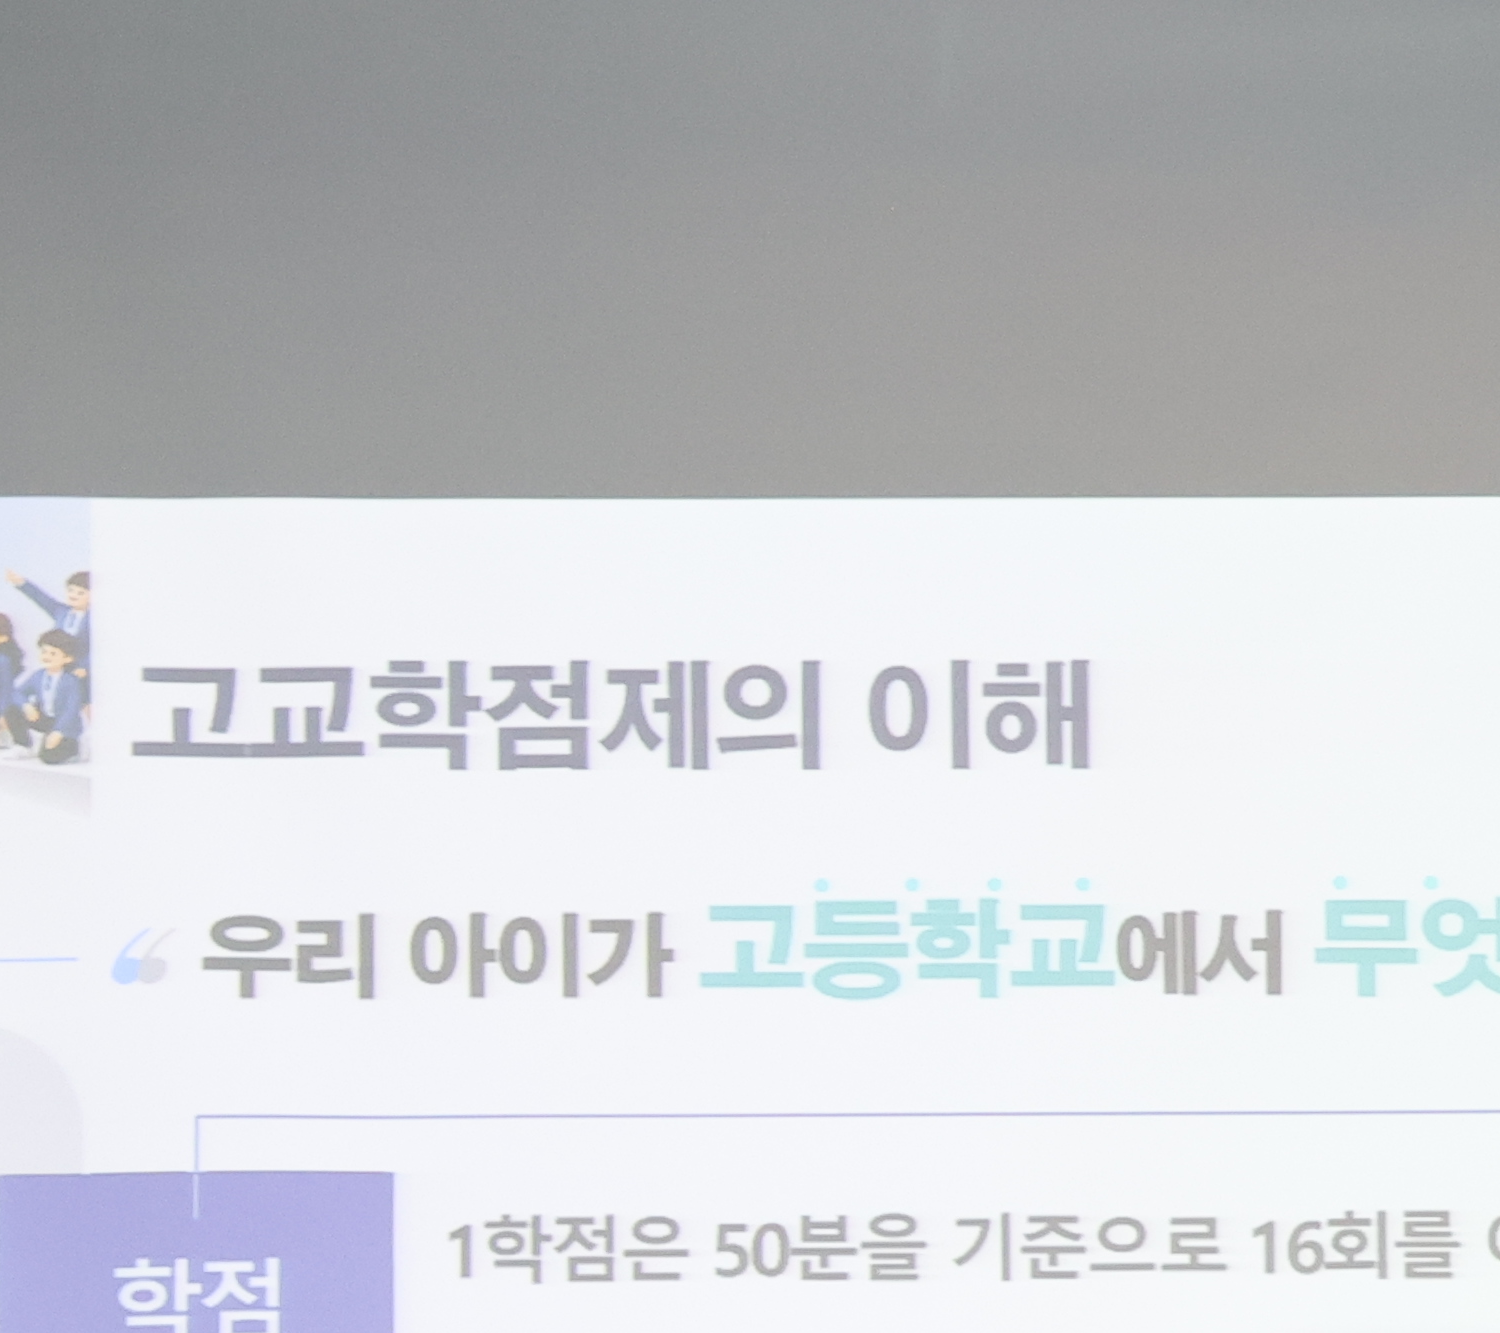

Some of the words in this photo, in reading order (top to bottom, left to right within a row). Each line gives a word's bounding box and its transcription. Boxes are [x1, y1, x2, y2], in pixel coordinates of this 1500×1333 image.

[130, 659, 822, 772] 고교학점제의
[867, 658, 1091, 771] 이해
[201, 912, 376, 1001] 우리
[408, 911, 676, 999] 아이가
[696, 896, 1286, 1001] 고등학교에서
[448, 1213, 691, 1285] 1학점은
[714, 1212, 928, 1282] 50분을
[953, 1211, 1229, 1282] 기준으로
[1252, 1209, 1462, 1280] 16회를
